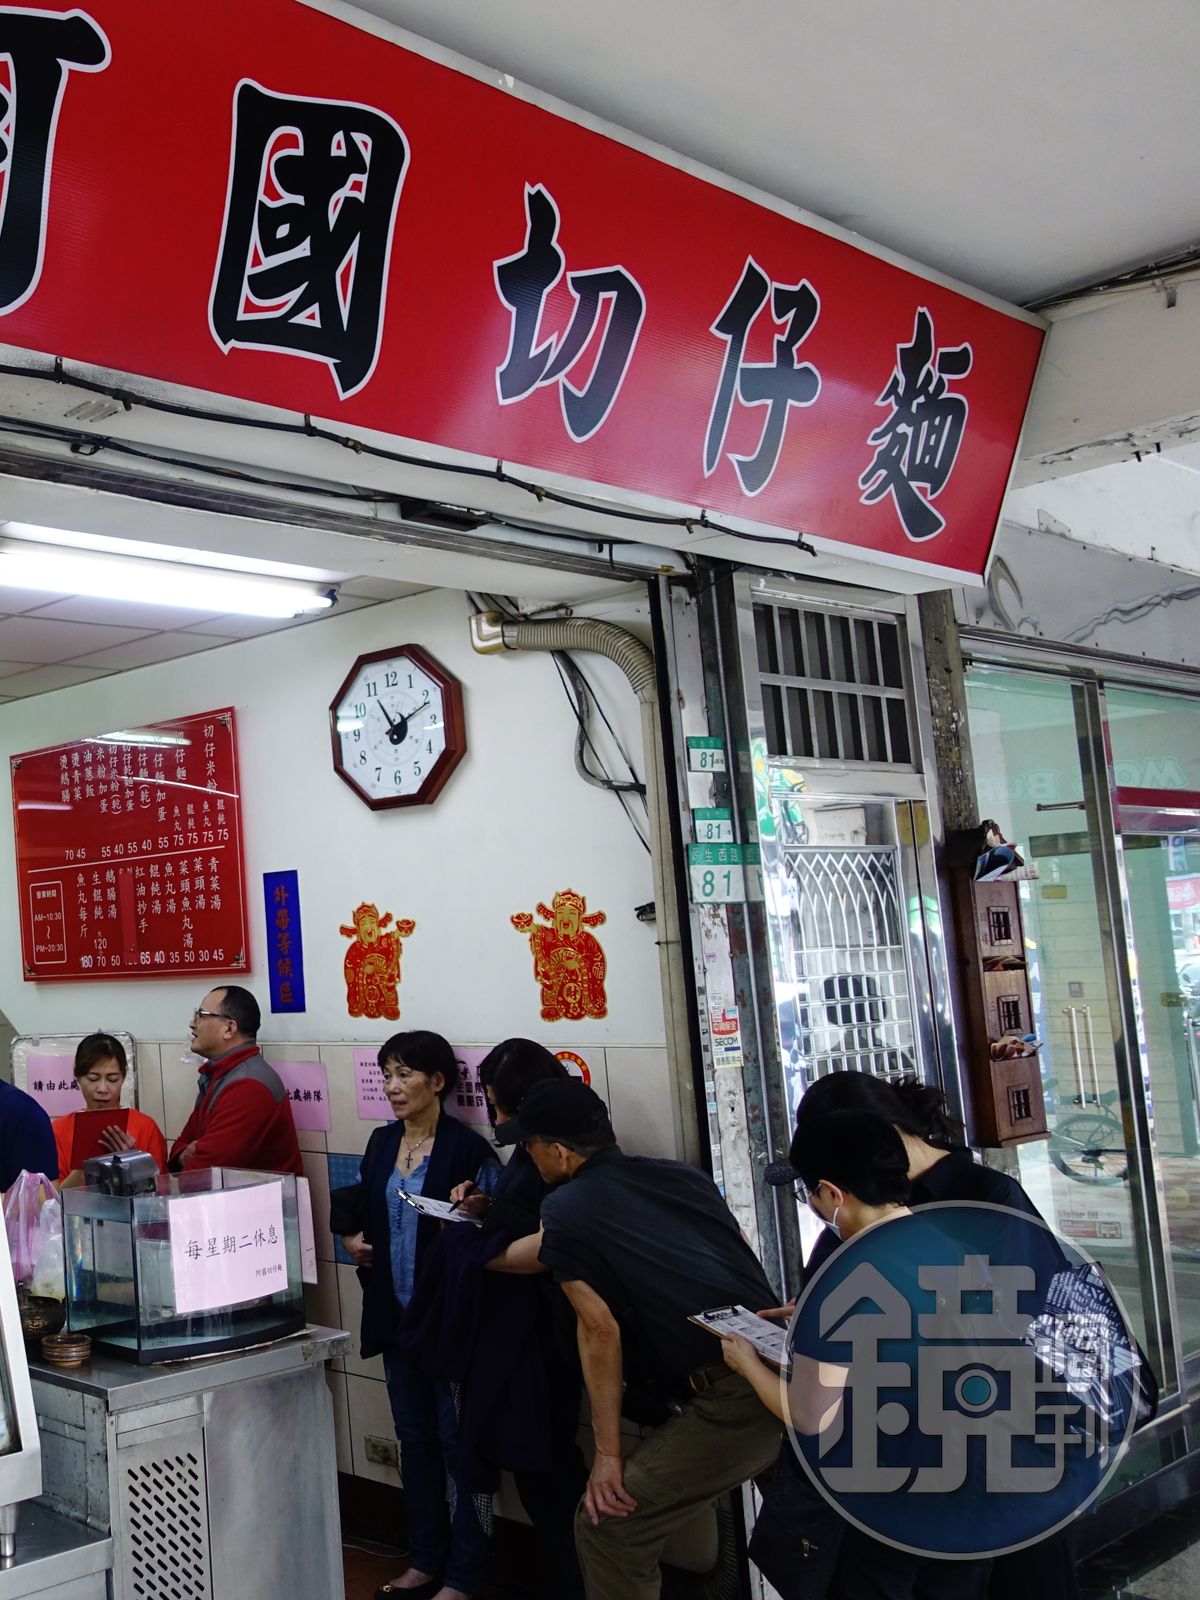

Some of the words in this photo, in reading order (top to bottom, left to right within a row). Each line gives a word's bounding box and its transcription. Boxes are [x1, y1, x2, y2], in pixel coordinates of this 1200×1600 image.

[384, 671, 398, 688] 12
[407, 674, 414, 688] 1
[366, 682, 378, 697] 11
[422, 689, 430, 703] 2
[354, 703, 366, 718] 10
[353, 729, 361, 742] 9
[426, 739, 433, 754] 4
[203, 725, 218, 794] 切仔米粉
[359, 751, 367, 765] 8
[700, 752, 715, 768] 81
[375, 767, 382, 782] 7
[414, 761, 422, 776] 5
[394, 770, 402, 785] 6
[203, 831, 214, 843] 75
[218, 829, 229, 841] 75
[706, 823, 721, 839] 81
[142, 840, 152, 850] 40
[158, 837, 169, 848] 55
[174, 835, 184, 846] 75
[188, 833, 198, 844] 75
[77, 849, 86, 859] 45
[101, 846, 111, 857] 55
[114, 844, 124, 855] 40
[128, 842, 138, 853] 55
[65, 850, 74, 860] 70
[164, 862, 176, 913] 魚丸湯
[194, 857, 206, 910] 菜頭湯
[208, 857, 221, 910] 青菜湯
[702, 870, 731, 897] 81
[135, 866, 148, 934] 紅油抄手
[179, 860, 193, 948] 菜頭魚丸湯
[94, 938, 107, 949] 120
[97, 956, 106, 967] 70
[111, 955, 120, 966] 50
[140, 951, 151, 965] 65
[154, 951, 165, 964] 40
[170, 952, 180, 963] 35
[185, 951, 195, 962] 50
[199, 950, 210, 961] 30
[213, 949, 224, 961] 45
[715, 1038, 738, 1047] SECOM
[33, 1080, 80, 1091] 請由此處
[185, 1224, 278, 1260] 每星期二休息
